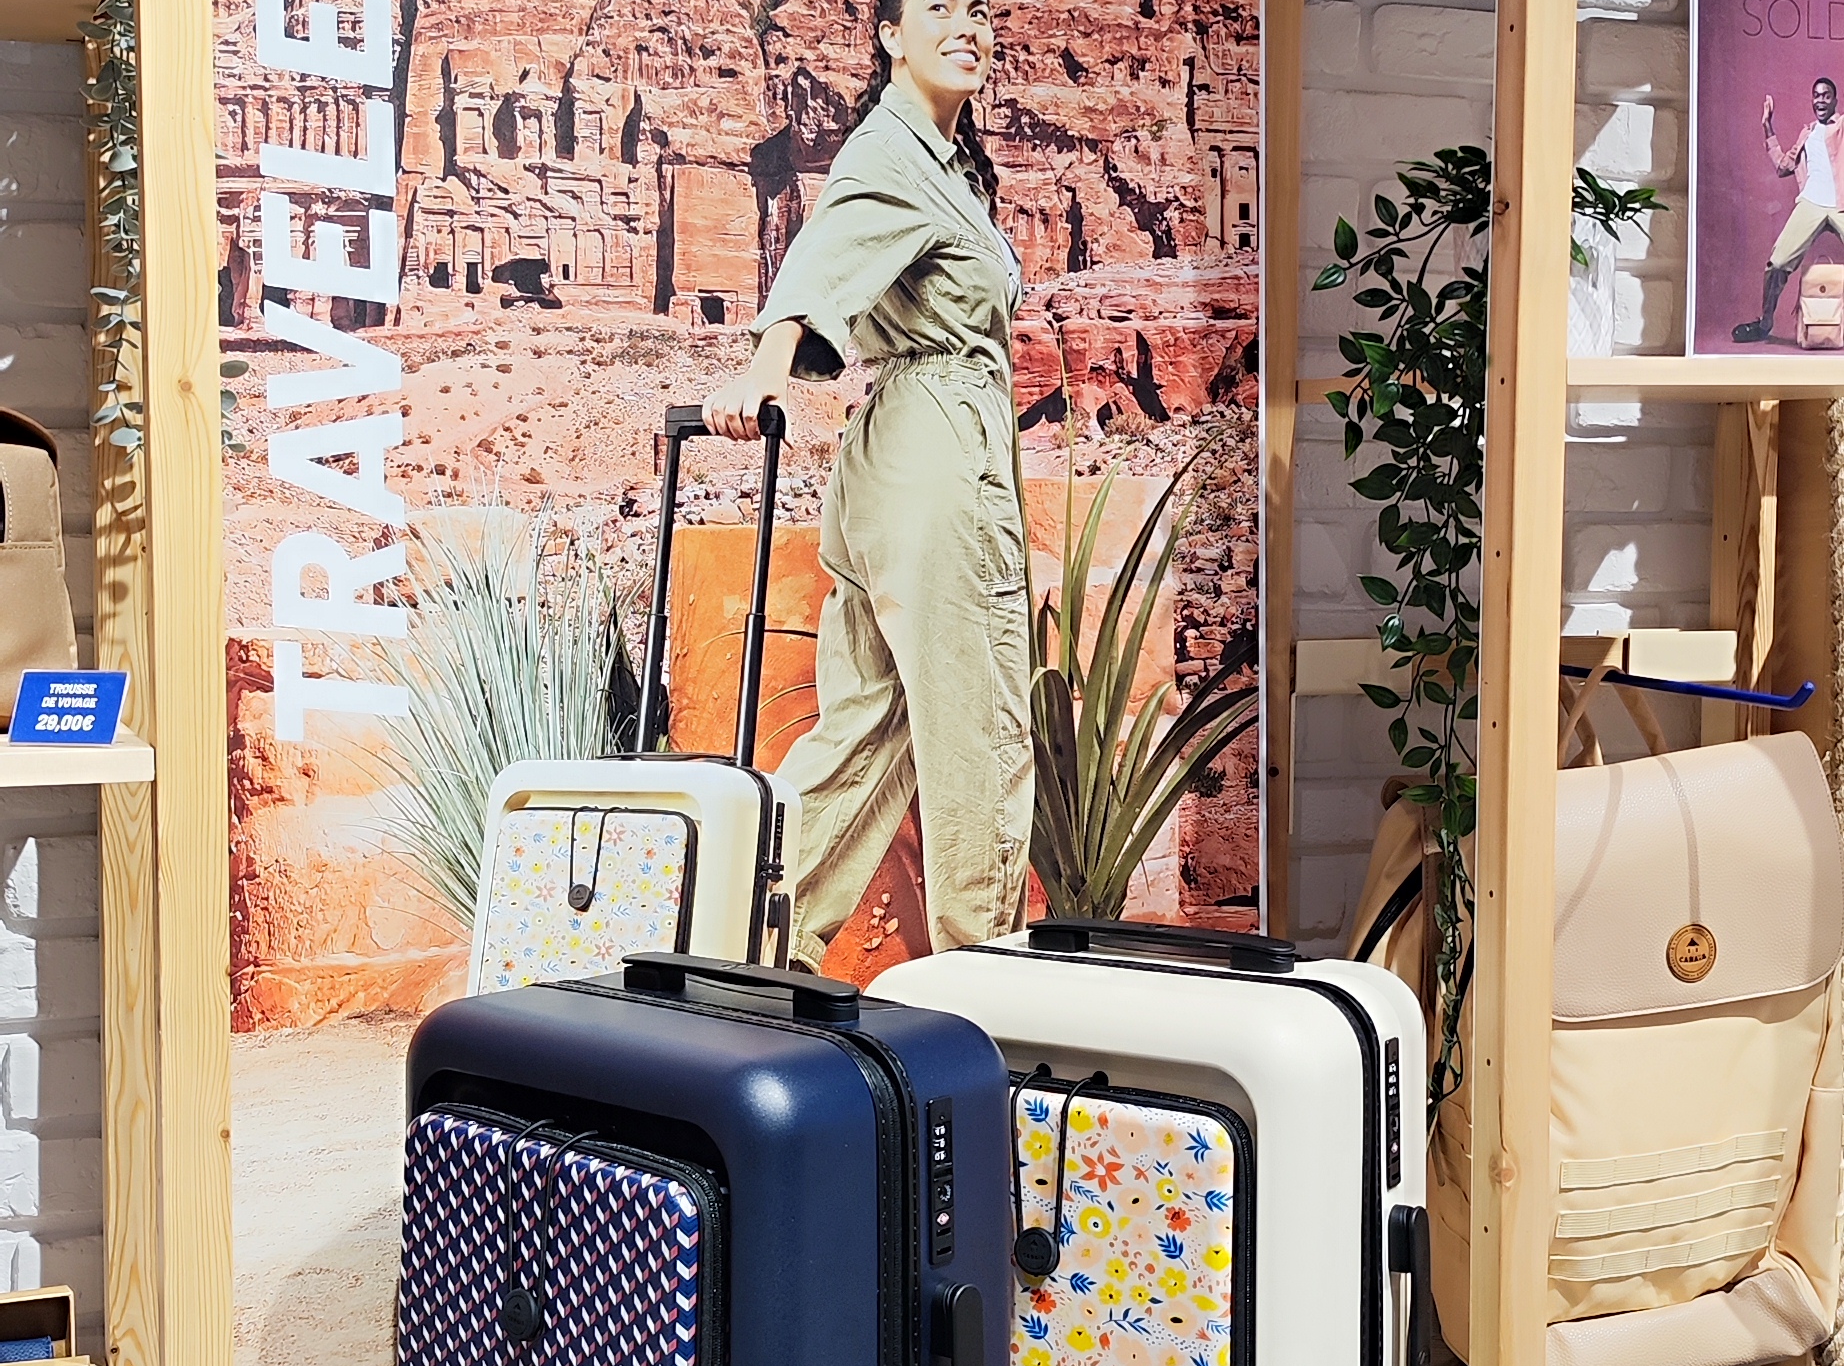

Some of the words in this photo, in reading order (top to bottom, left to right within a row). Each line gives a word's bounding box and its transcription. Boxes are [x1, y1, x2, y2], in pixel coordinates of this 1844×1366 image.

[49, 683, 98, 695] TROUSSE
[41, 696, 57, 708] DE
[58, 696, 98, 709] VOYAGE
[34, 714, 96, 733] 29,00€
